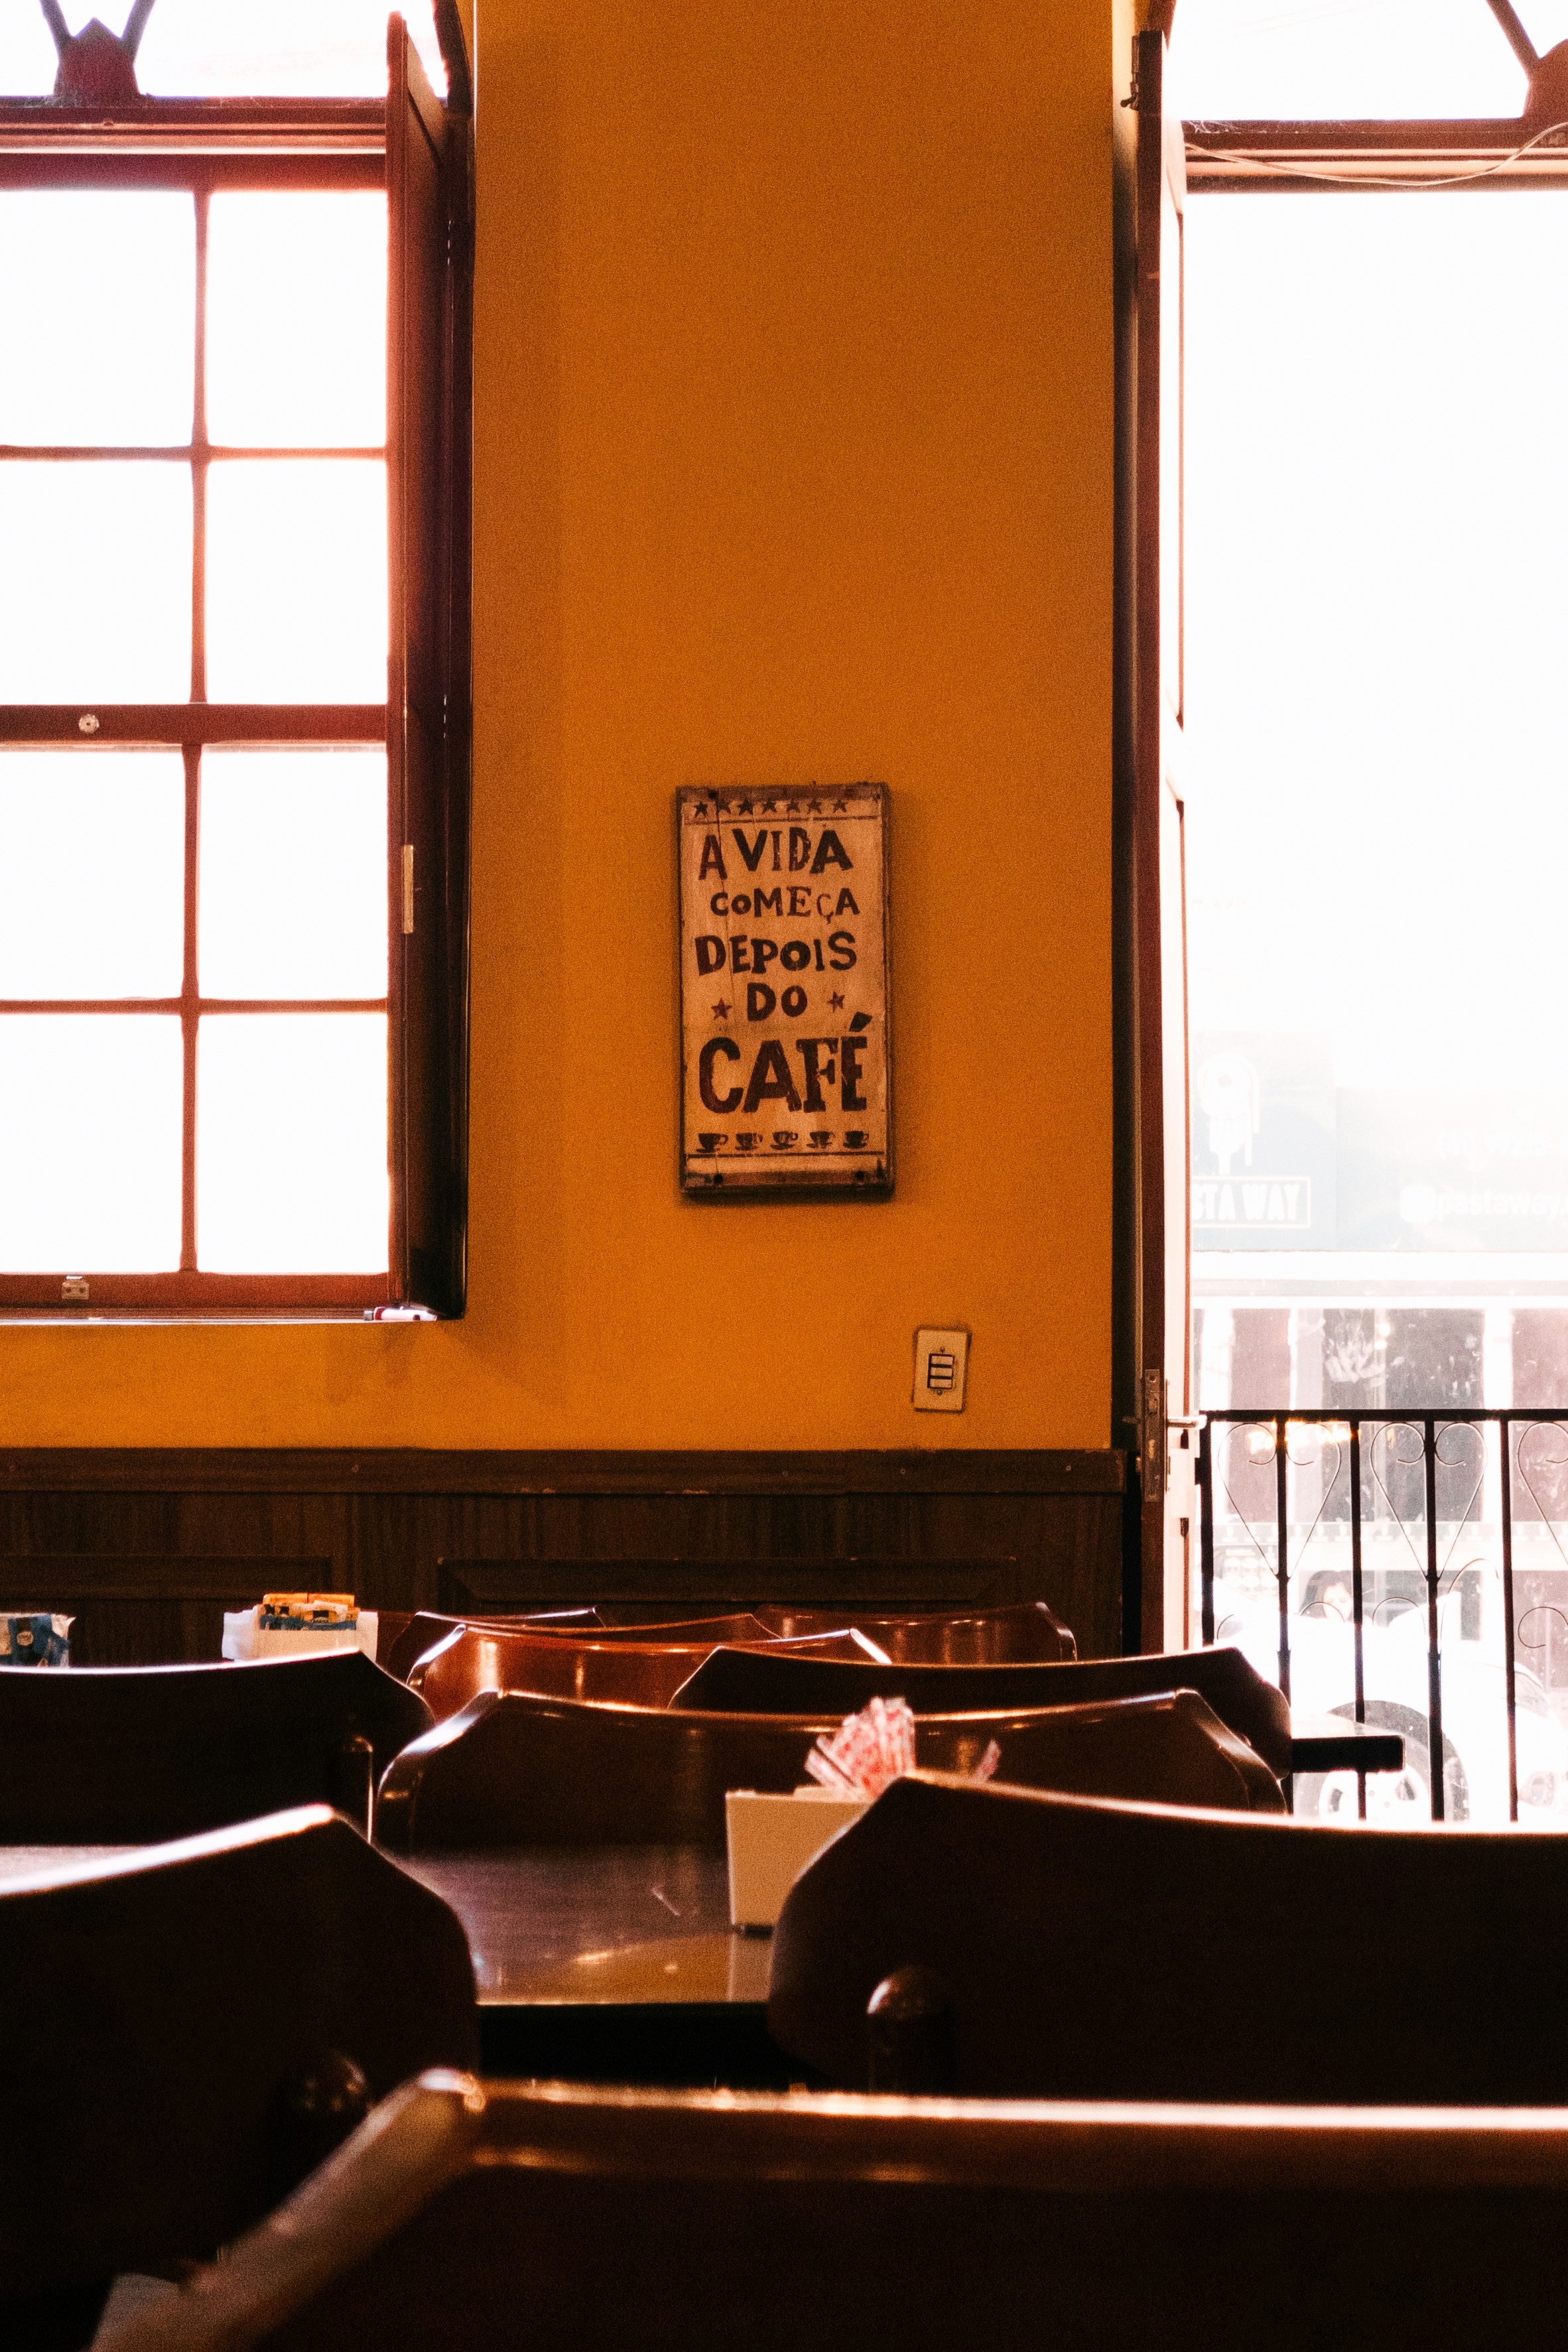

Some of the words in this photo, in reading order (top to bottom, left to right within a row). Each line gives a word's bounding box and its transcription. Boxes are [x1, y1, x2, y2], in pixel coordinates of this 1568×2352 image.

[698, 834, 728, 880] A
[732, 826, 854, 875] VIDA
[694, 931, 858, 976] DEPOIS
[747, 982, 809, 1021] DO
[698, 1012, 873, 1114] CAFÉ
[1241, 1183, 1301, 1221] WAY
